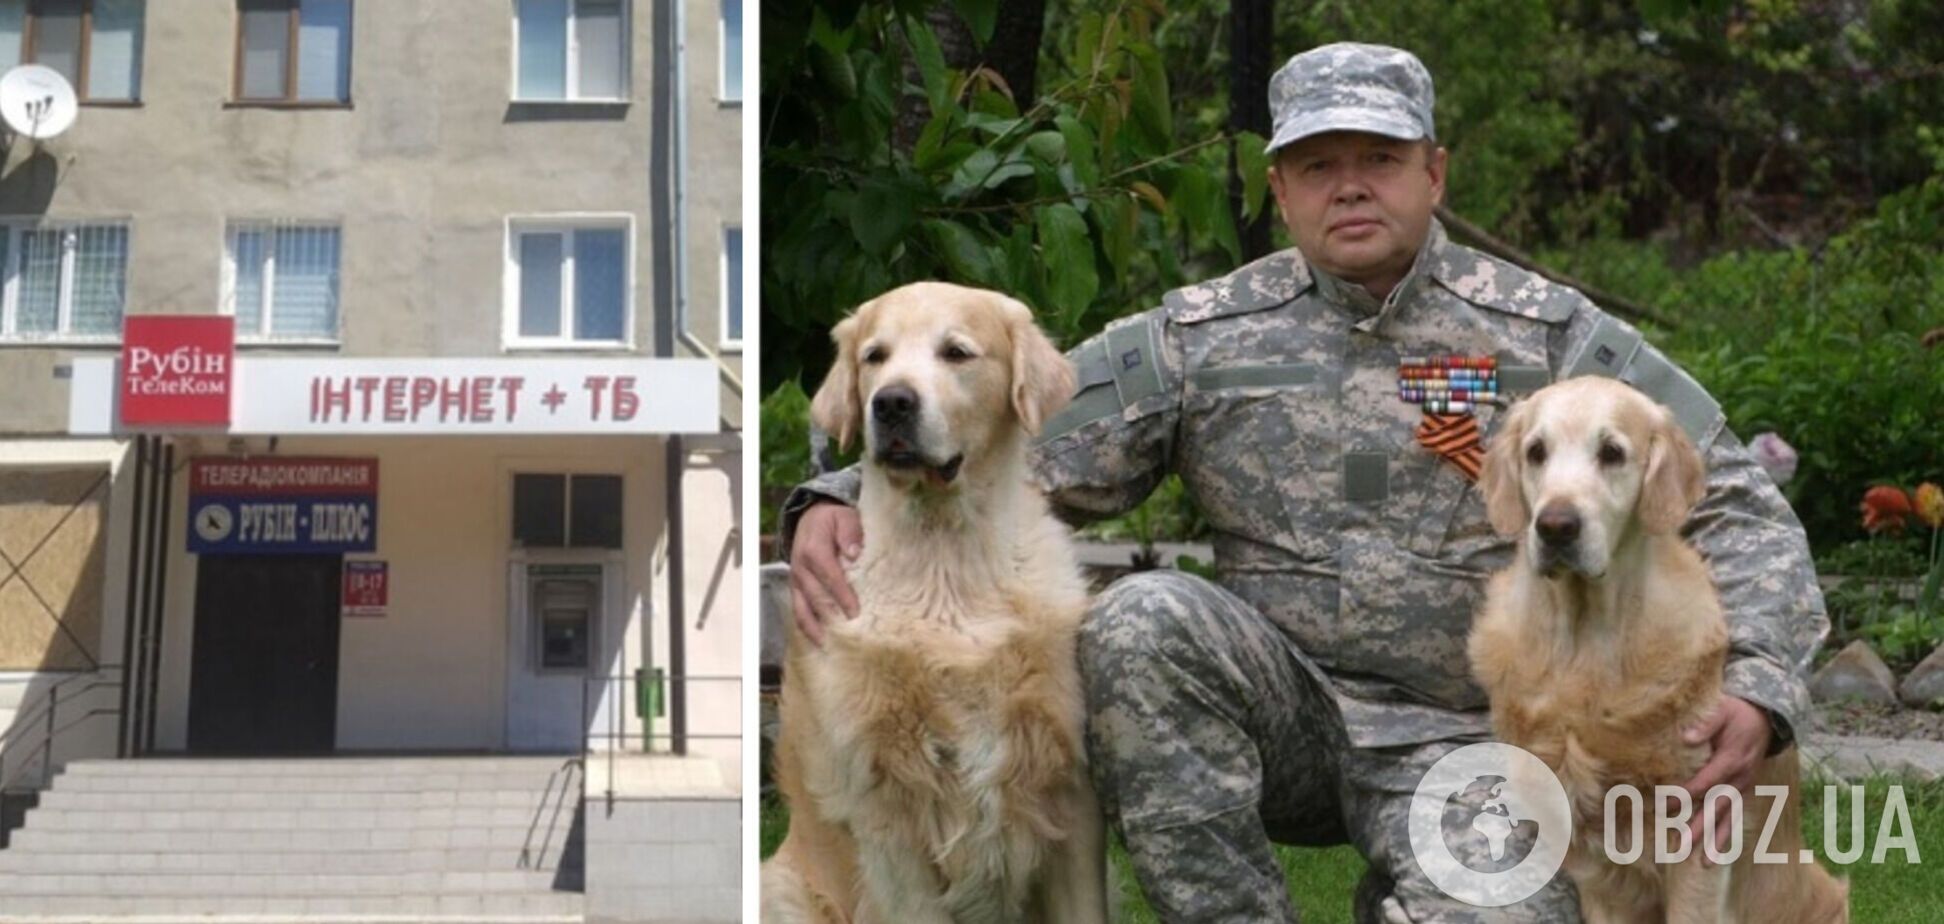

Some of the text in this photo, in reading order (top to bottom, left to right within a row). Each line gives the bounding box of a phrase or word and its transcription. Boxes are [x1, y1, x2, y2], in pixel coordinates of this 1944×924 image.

[128, 346, 225, 377] Рубін
[127, 376, 225, 395] ТелеКом
[309, 376, 640, 423] ІНТЕРНЕТ + ТБ
[201, 464, 370, 487] ТЕЛЕРАДІОКОМПАНІЯ
[239, 503, 298, 542] РУБІН
[311, 503, 370, 542] ПЛЮС
